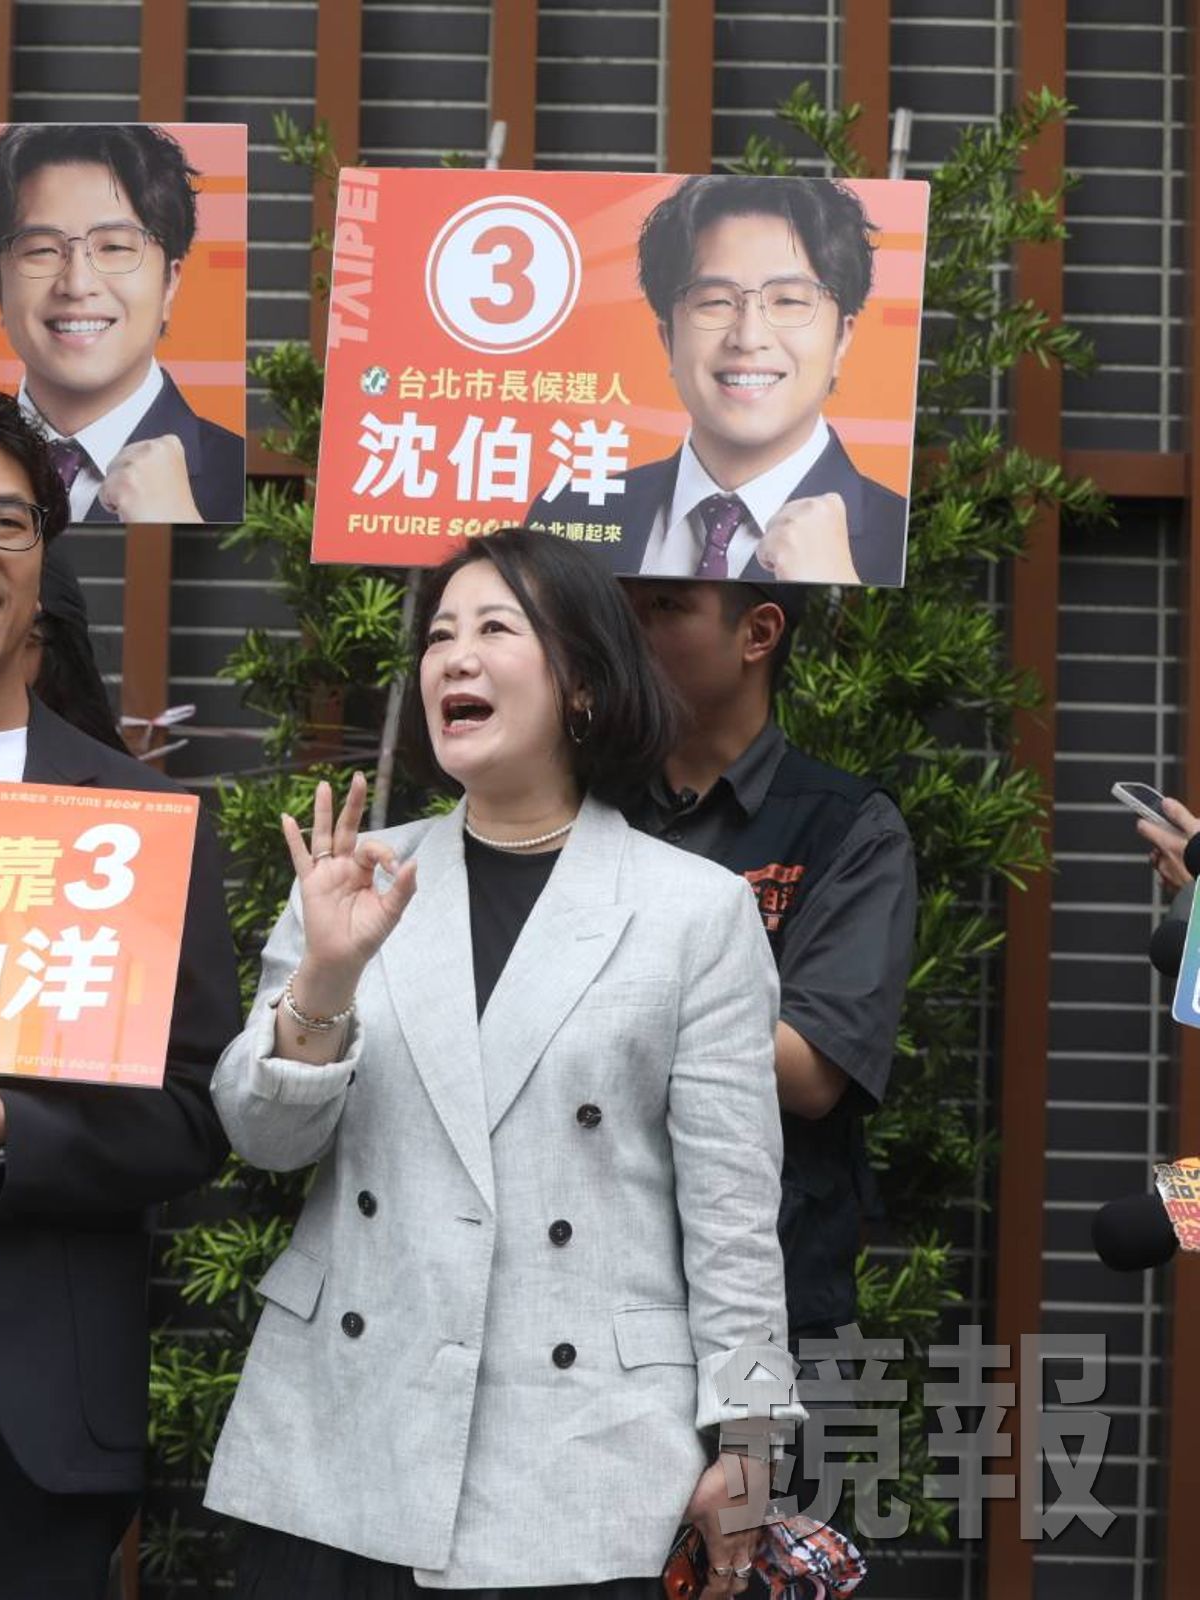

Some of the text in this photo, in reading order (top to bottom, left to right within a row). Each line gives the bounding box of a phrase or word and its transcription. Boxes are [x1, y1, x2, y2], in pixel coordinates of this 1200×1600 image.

[328, 167, 380, 349] TAIPEI
[470, 224, 536, 326] 3
[397, 366, 632, 406] 台北市長候選人
[351, 412, 631, 507] 沈伯洋
[347, 514, 441, 536] FUTURE
[53, 795, 100, 808] FUTURE
